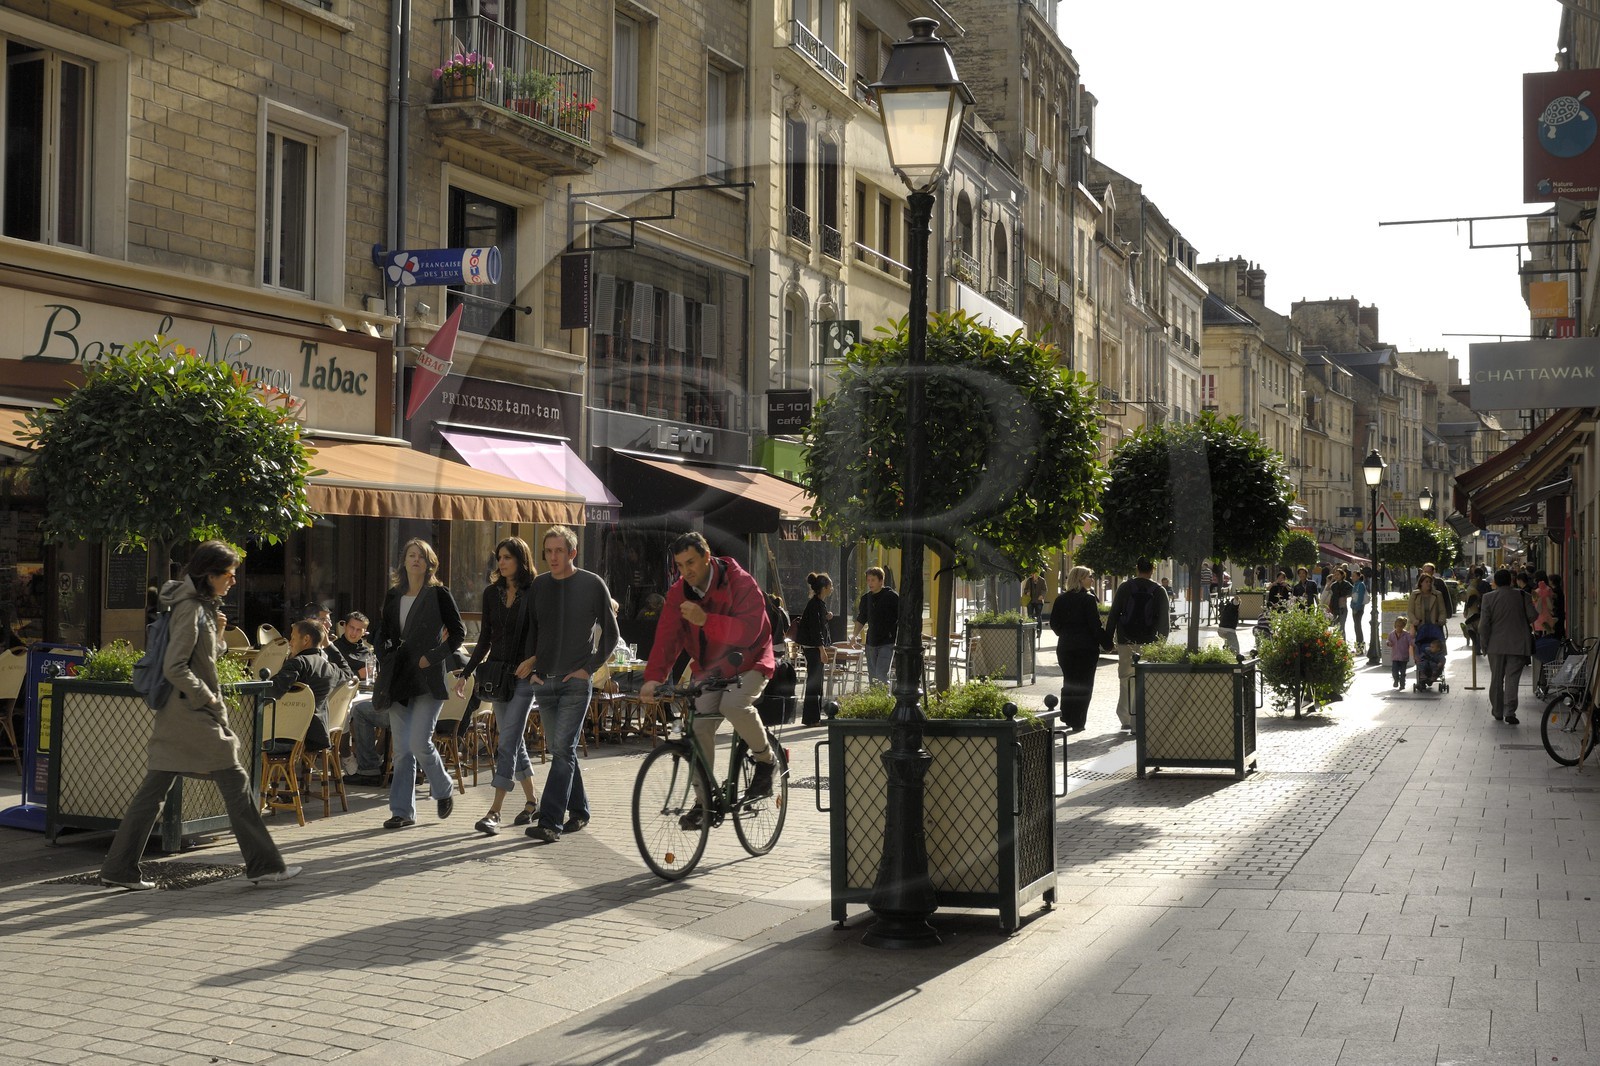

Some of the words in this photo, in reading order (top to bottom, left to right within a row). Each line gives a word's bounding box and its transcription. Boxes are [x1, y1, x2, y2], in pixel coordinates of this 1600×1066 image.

[469, 249, 482, 283] LOTO
[440, 270, 459, 278] JEUX
[1532, 306, 1565, 315] orange
[22, 304, 124, 364] Bar
[299, 340, 369, 396] Tabac
[1474, 366, 1595, 383] CHATTAWAK
[441, 391, 503, 412] PRINCESSE
[769, 403, 785, 412] LE
[787, 402, 810, 412] 101
[777, 416, 801, 425] café
[654, 424, 680, 451] LE
[679, 429, 714, 456] 101
[788, 524, 798, 536] LE
